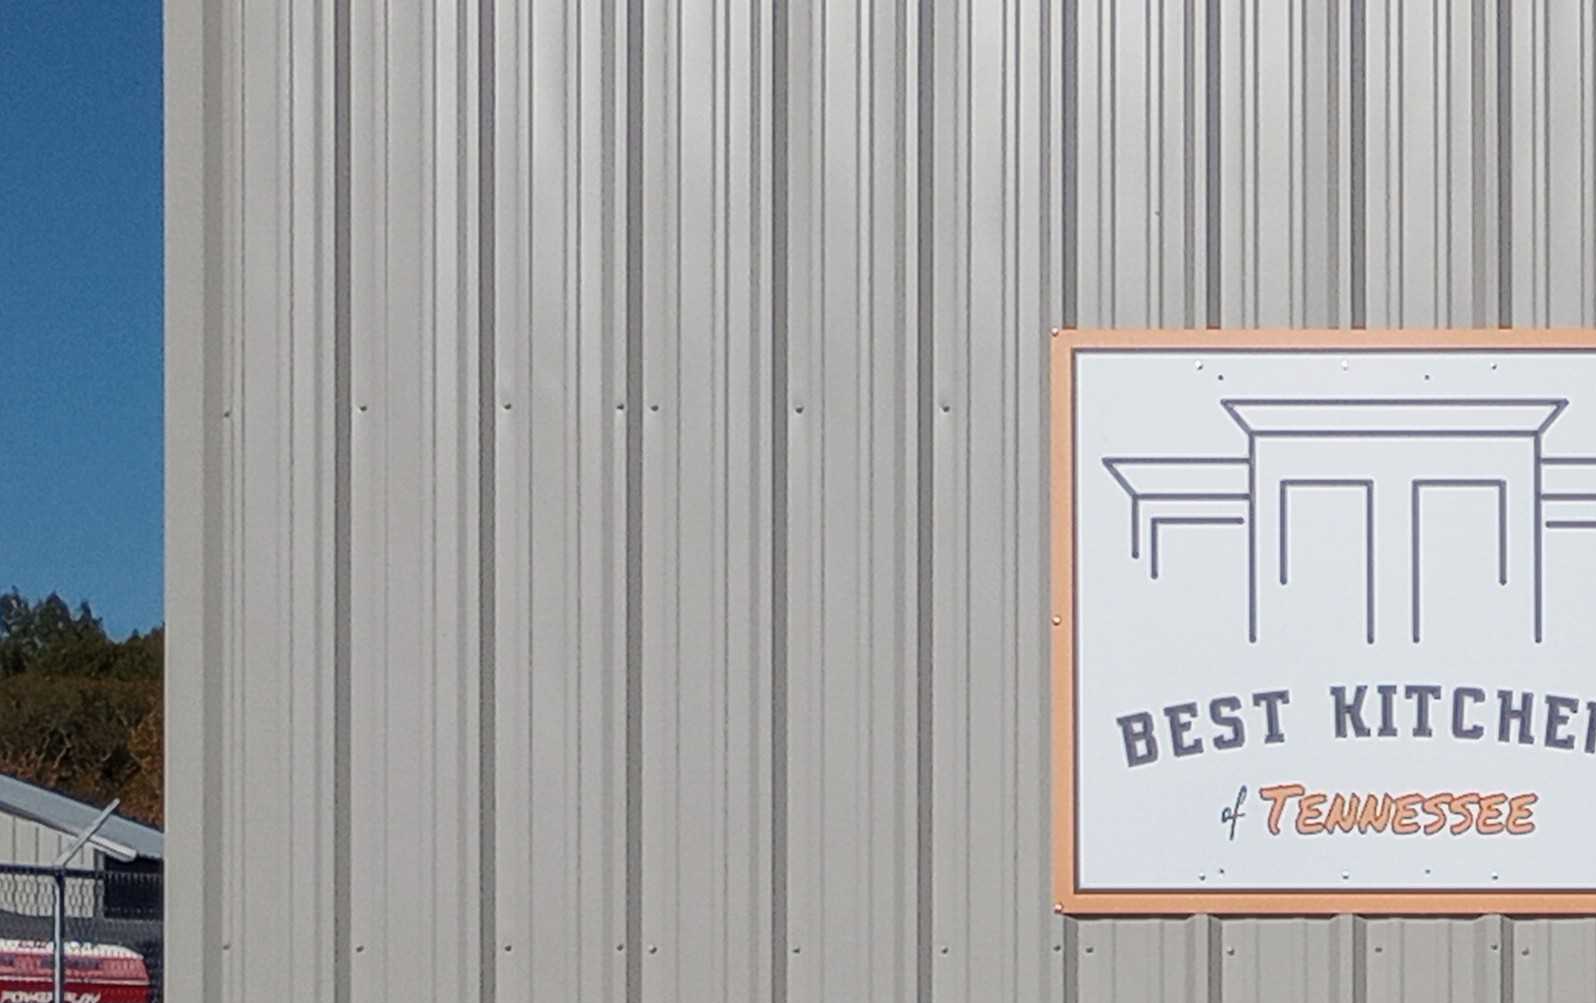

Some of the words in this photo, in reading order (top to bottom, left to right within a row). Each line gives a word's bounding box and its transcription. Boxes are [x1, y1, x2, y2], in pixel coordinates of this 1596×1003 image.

[1115, 689, 1290, 768] BEST
[1220, 784, 1248, 841] of
[1258, 783, 1539, 837] TENNESSEE
